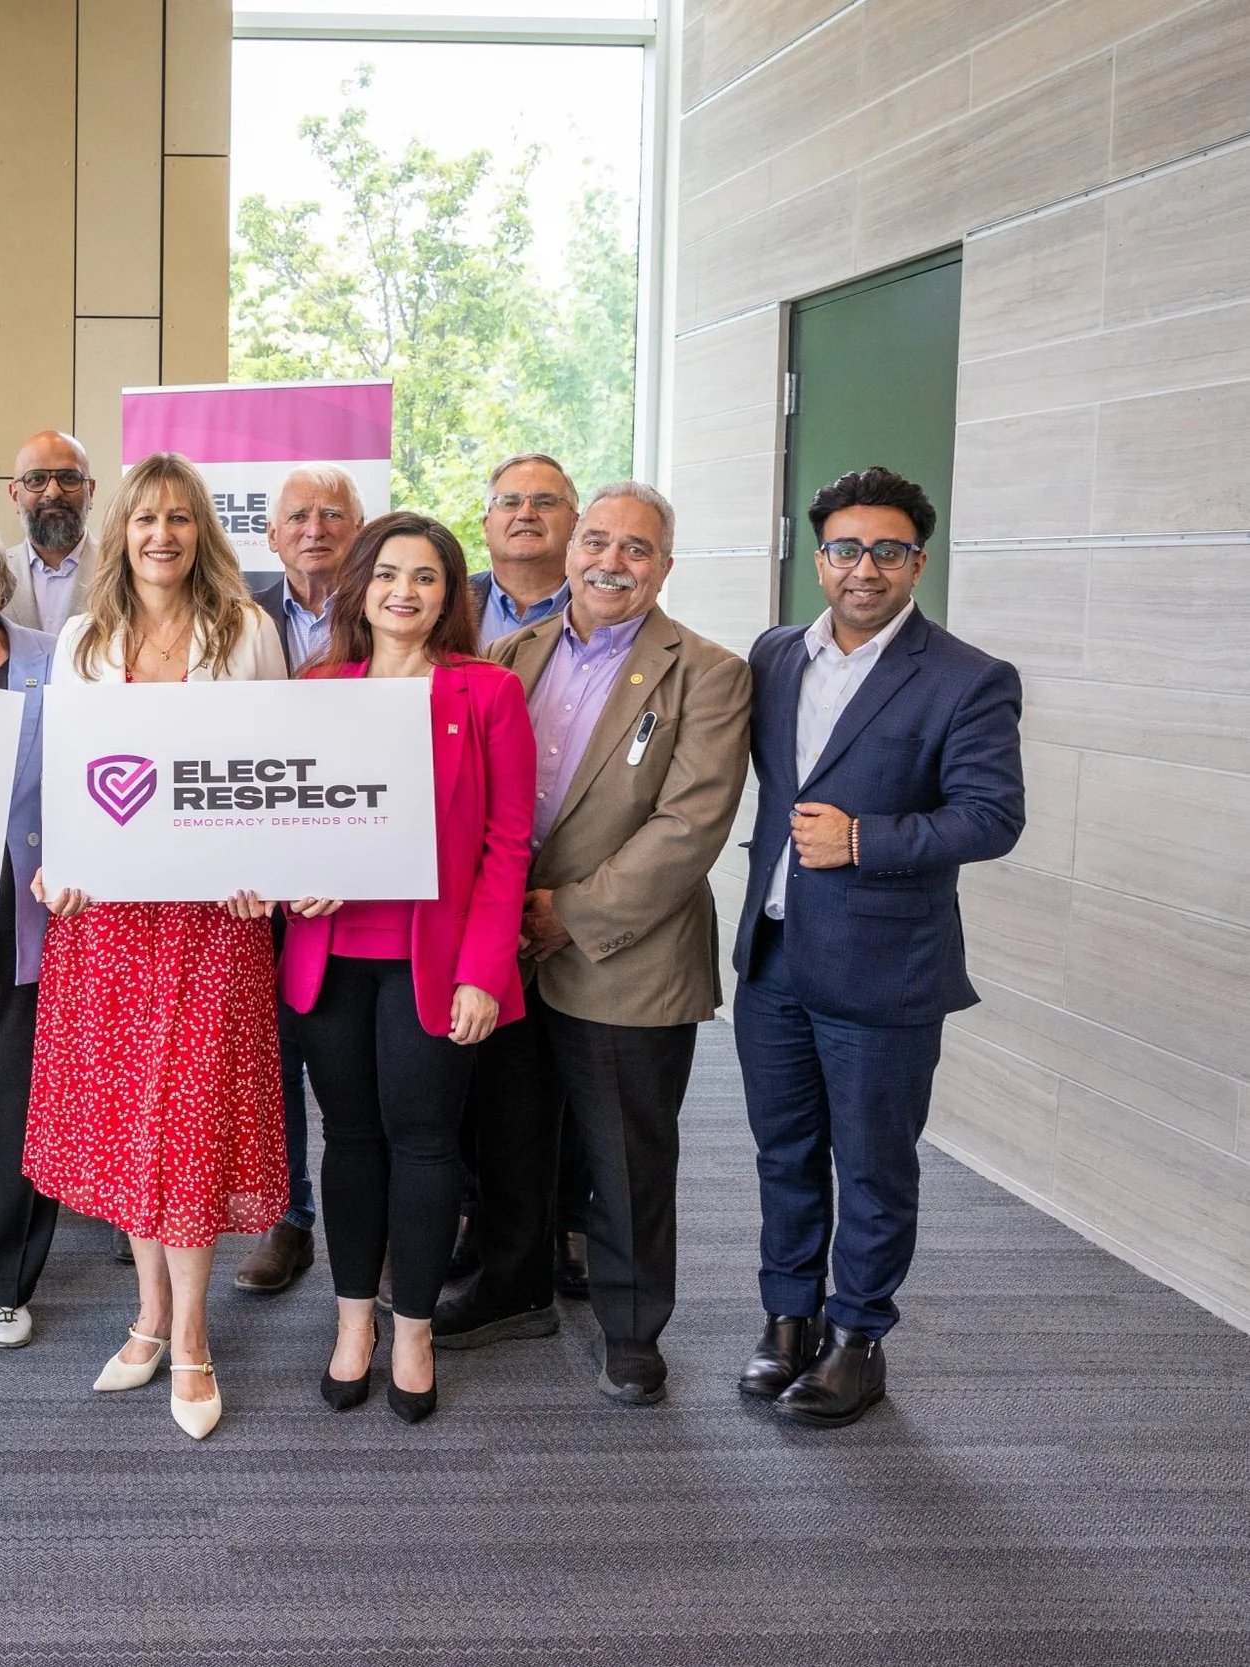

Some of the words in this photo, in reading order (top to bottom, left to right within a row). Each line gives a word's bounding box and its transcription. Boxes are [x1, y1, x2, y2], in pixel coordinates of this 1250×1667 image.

[172, 758, 317, 784] ELECT
[173, 784, 388, 811] RESPECT
[173, 817, 265, 827] DEMOCRACY
[271, 816, 341, 826] DEPENDS
[347, 816, 367, 825] ON
[373, 815, 389, 825] IT
